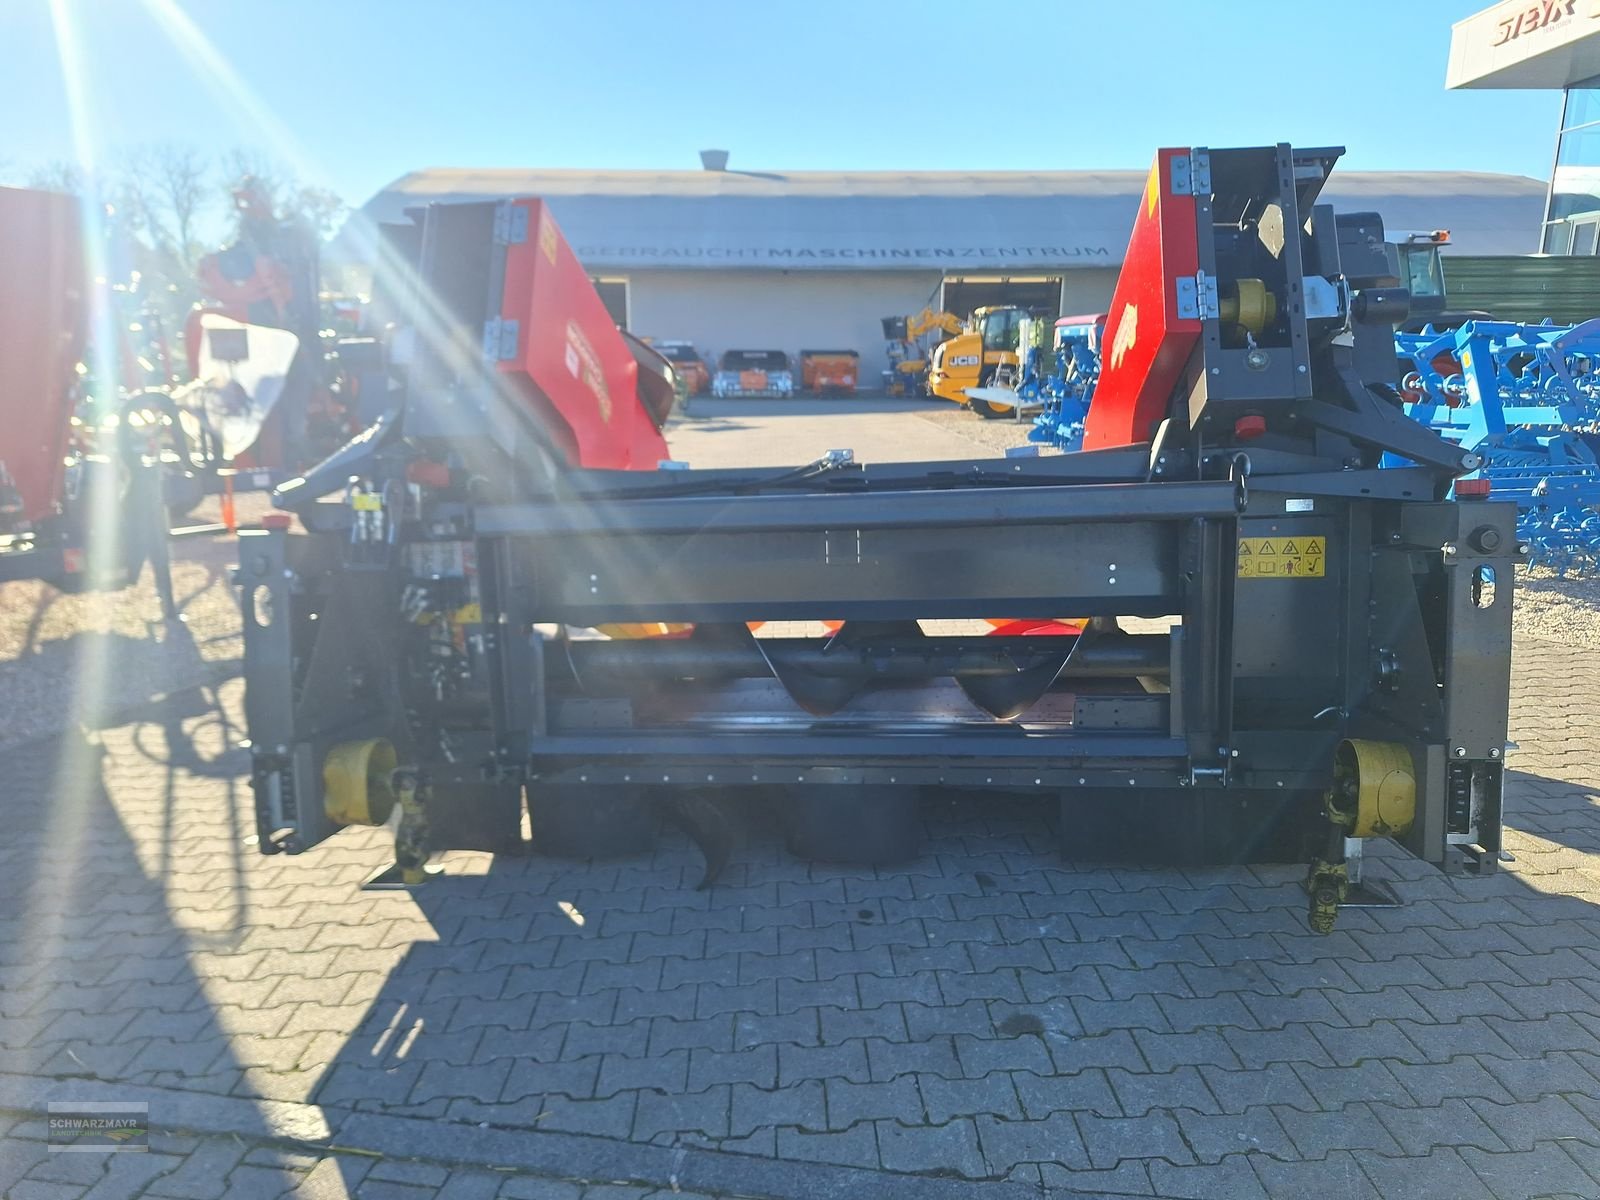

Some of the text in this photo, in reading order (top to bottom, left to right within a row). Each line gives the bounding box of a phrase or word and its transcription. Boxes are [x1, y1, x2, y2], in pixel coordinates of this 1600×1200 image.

[1490, 0, 1577, 47] STEYR
[577, 246, 1109, 258] GEBRAUCHTMASCHINENZENTRUM
[949, 355, 978, 366] JCB
